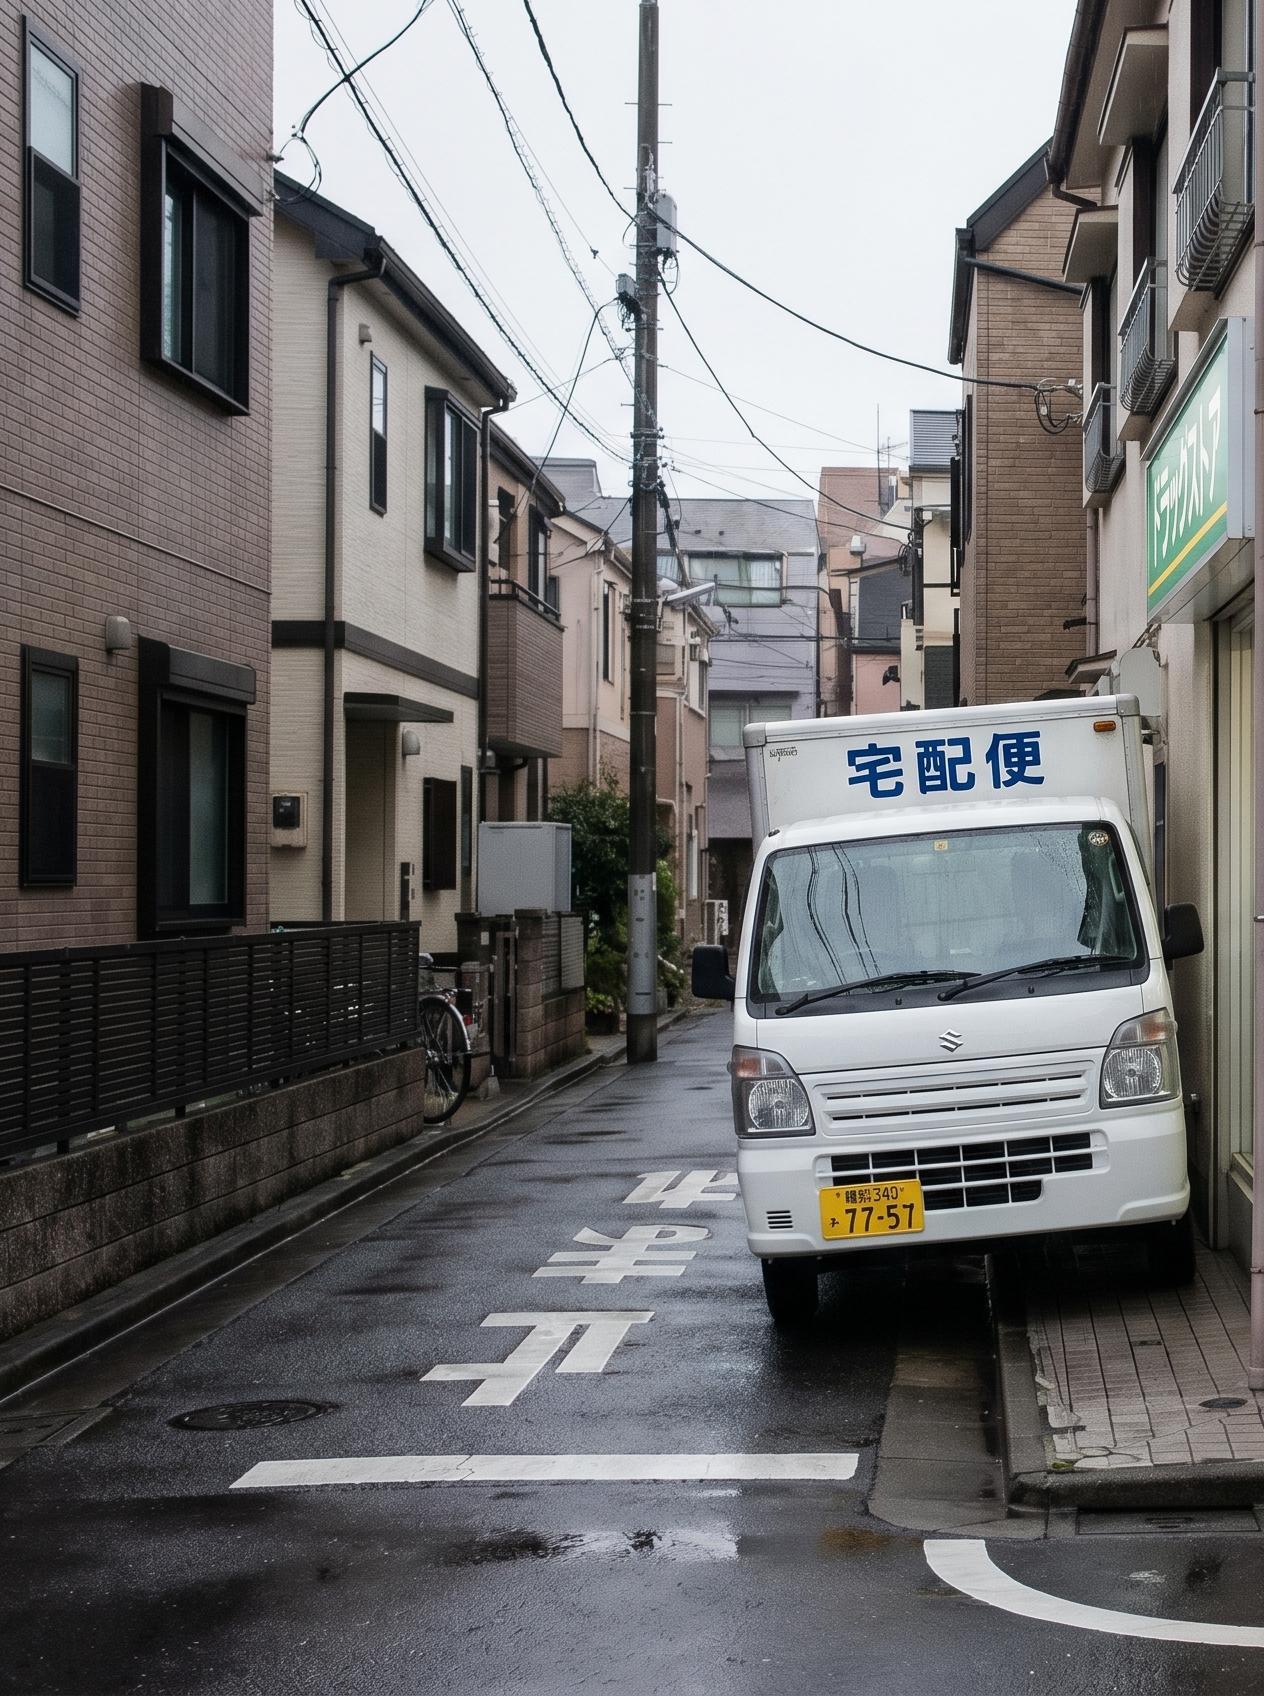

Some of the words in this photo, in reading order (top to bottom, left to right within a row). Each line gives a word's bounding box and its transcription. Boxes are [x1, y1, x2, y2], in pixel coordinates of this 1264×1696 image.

[1154, 384, 1220, 568] ドラッグストア
[847, 730, 1045, 799] 宅配便
[844, 1203, 915, 1234] 77-57
